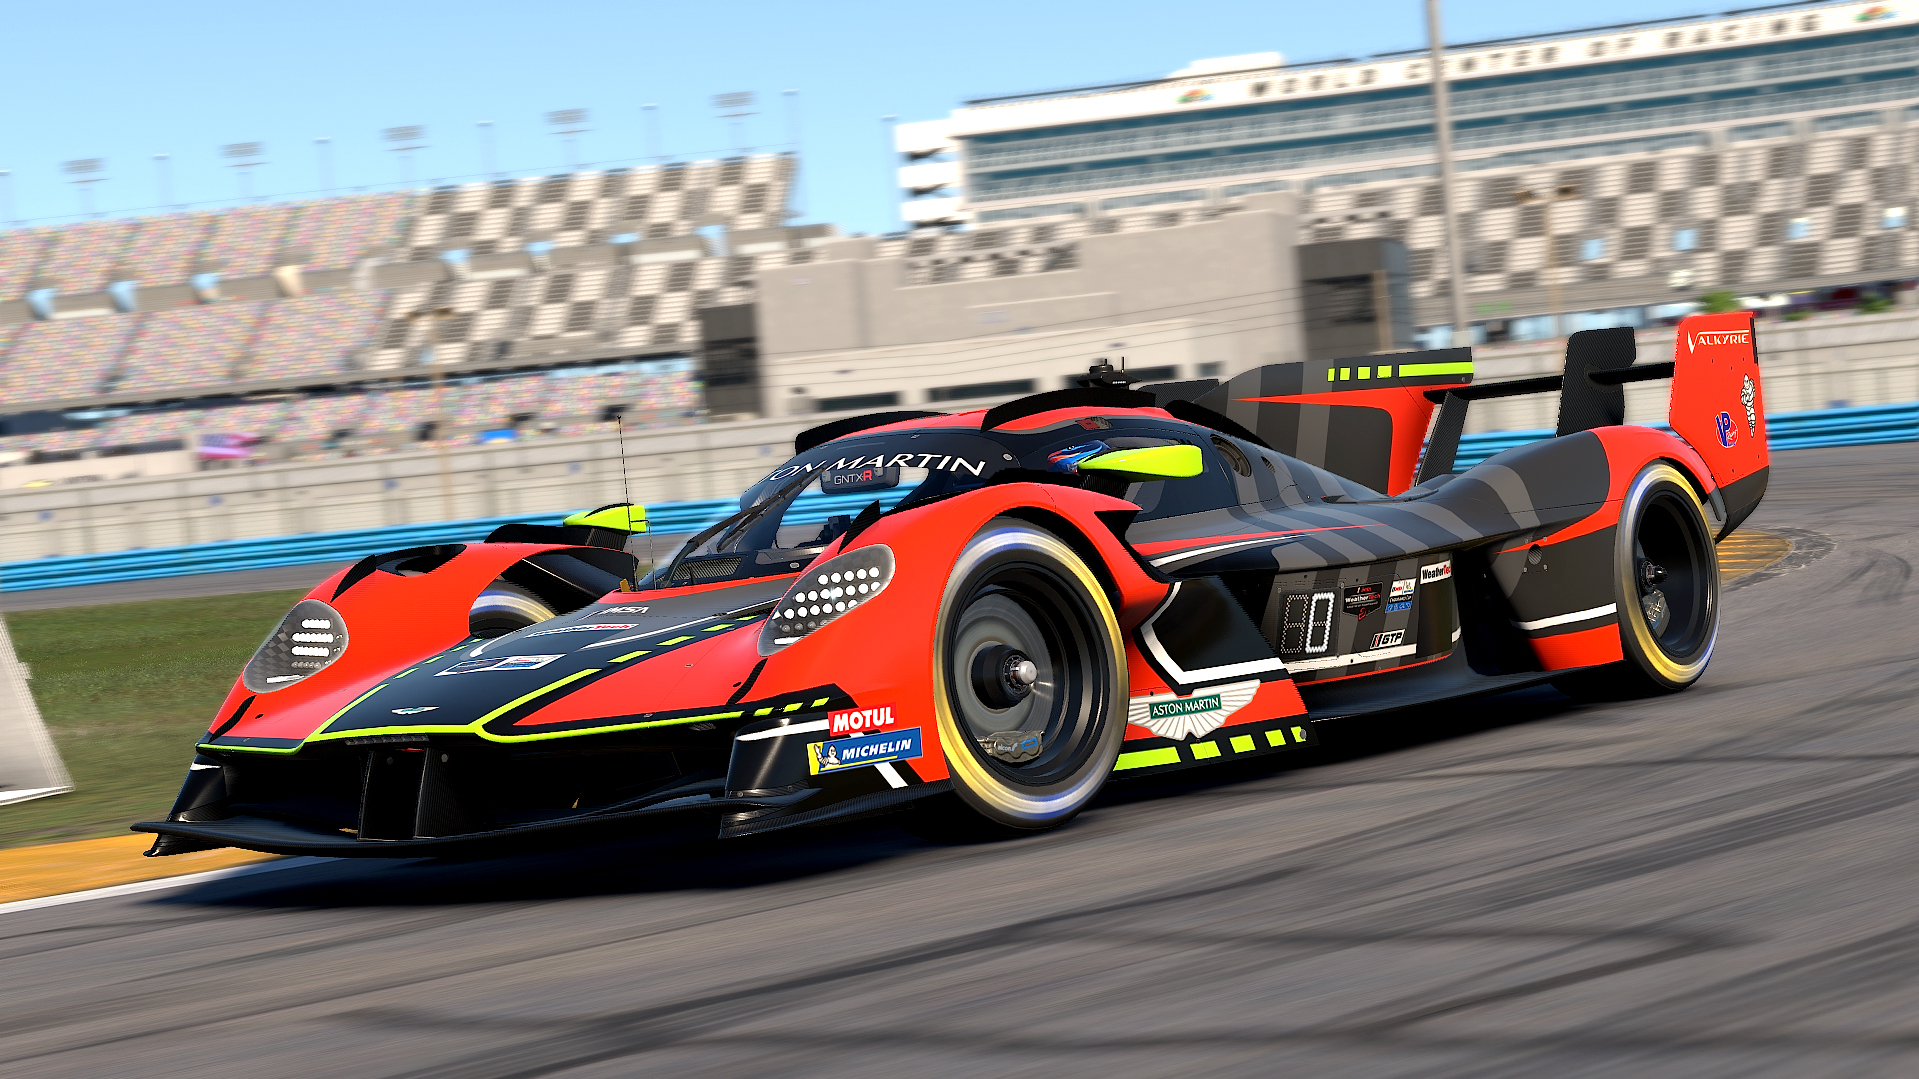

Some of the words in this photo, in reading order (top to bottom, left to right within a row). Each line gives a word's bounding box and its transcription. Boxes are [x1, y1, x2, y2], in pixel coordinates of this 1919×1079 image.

[1687, 329, 1750, 354] VALKYRIE
[825, 453, 986, 477] MARTIN
[1422, 564, 1452, 580] WeatherTec
[1381, 631, 1403, 645] GTP
[1152, 702, 1183, 717] ASTON
[1185, 696, 1219, 712] MARTIN
[832, 706, 895, 733] MOTUL
[842, 738, 912, 761] MICHELIN
